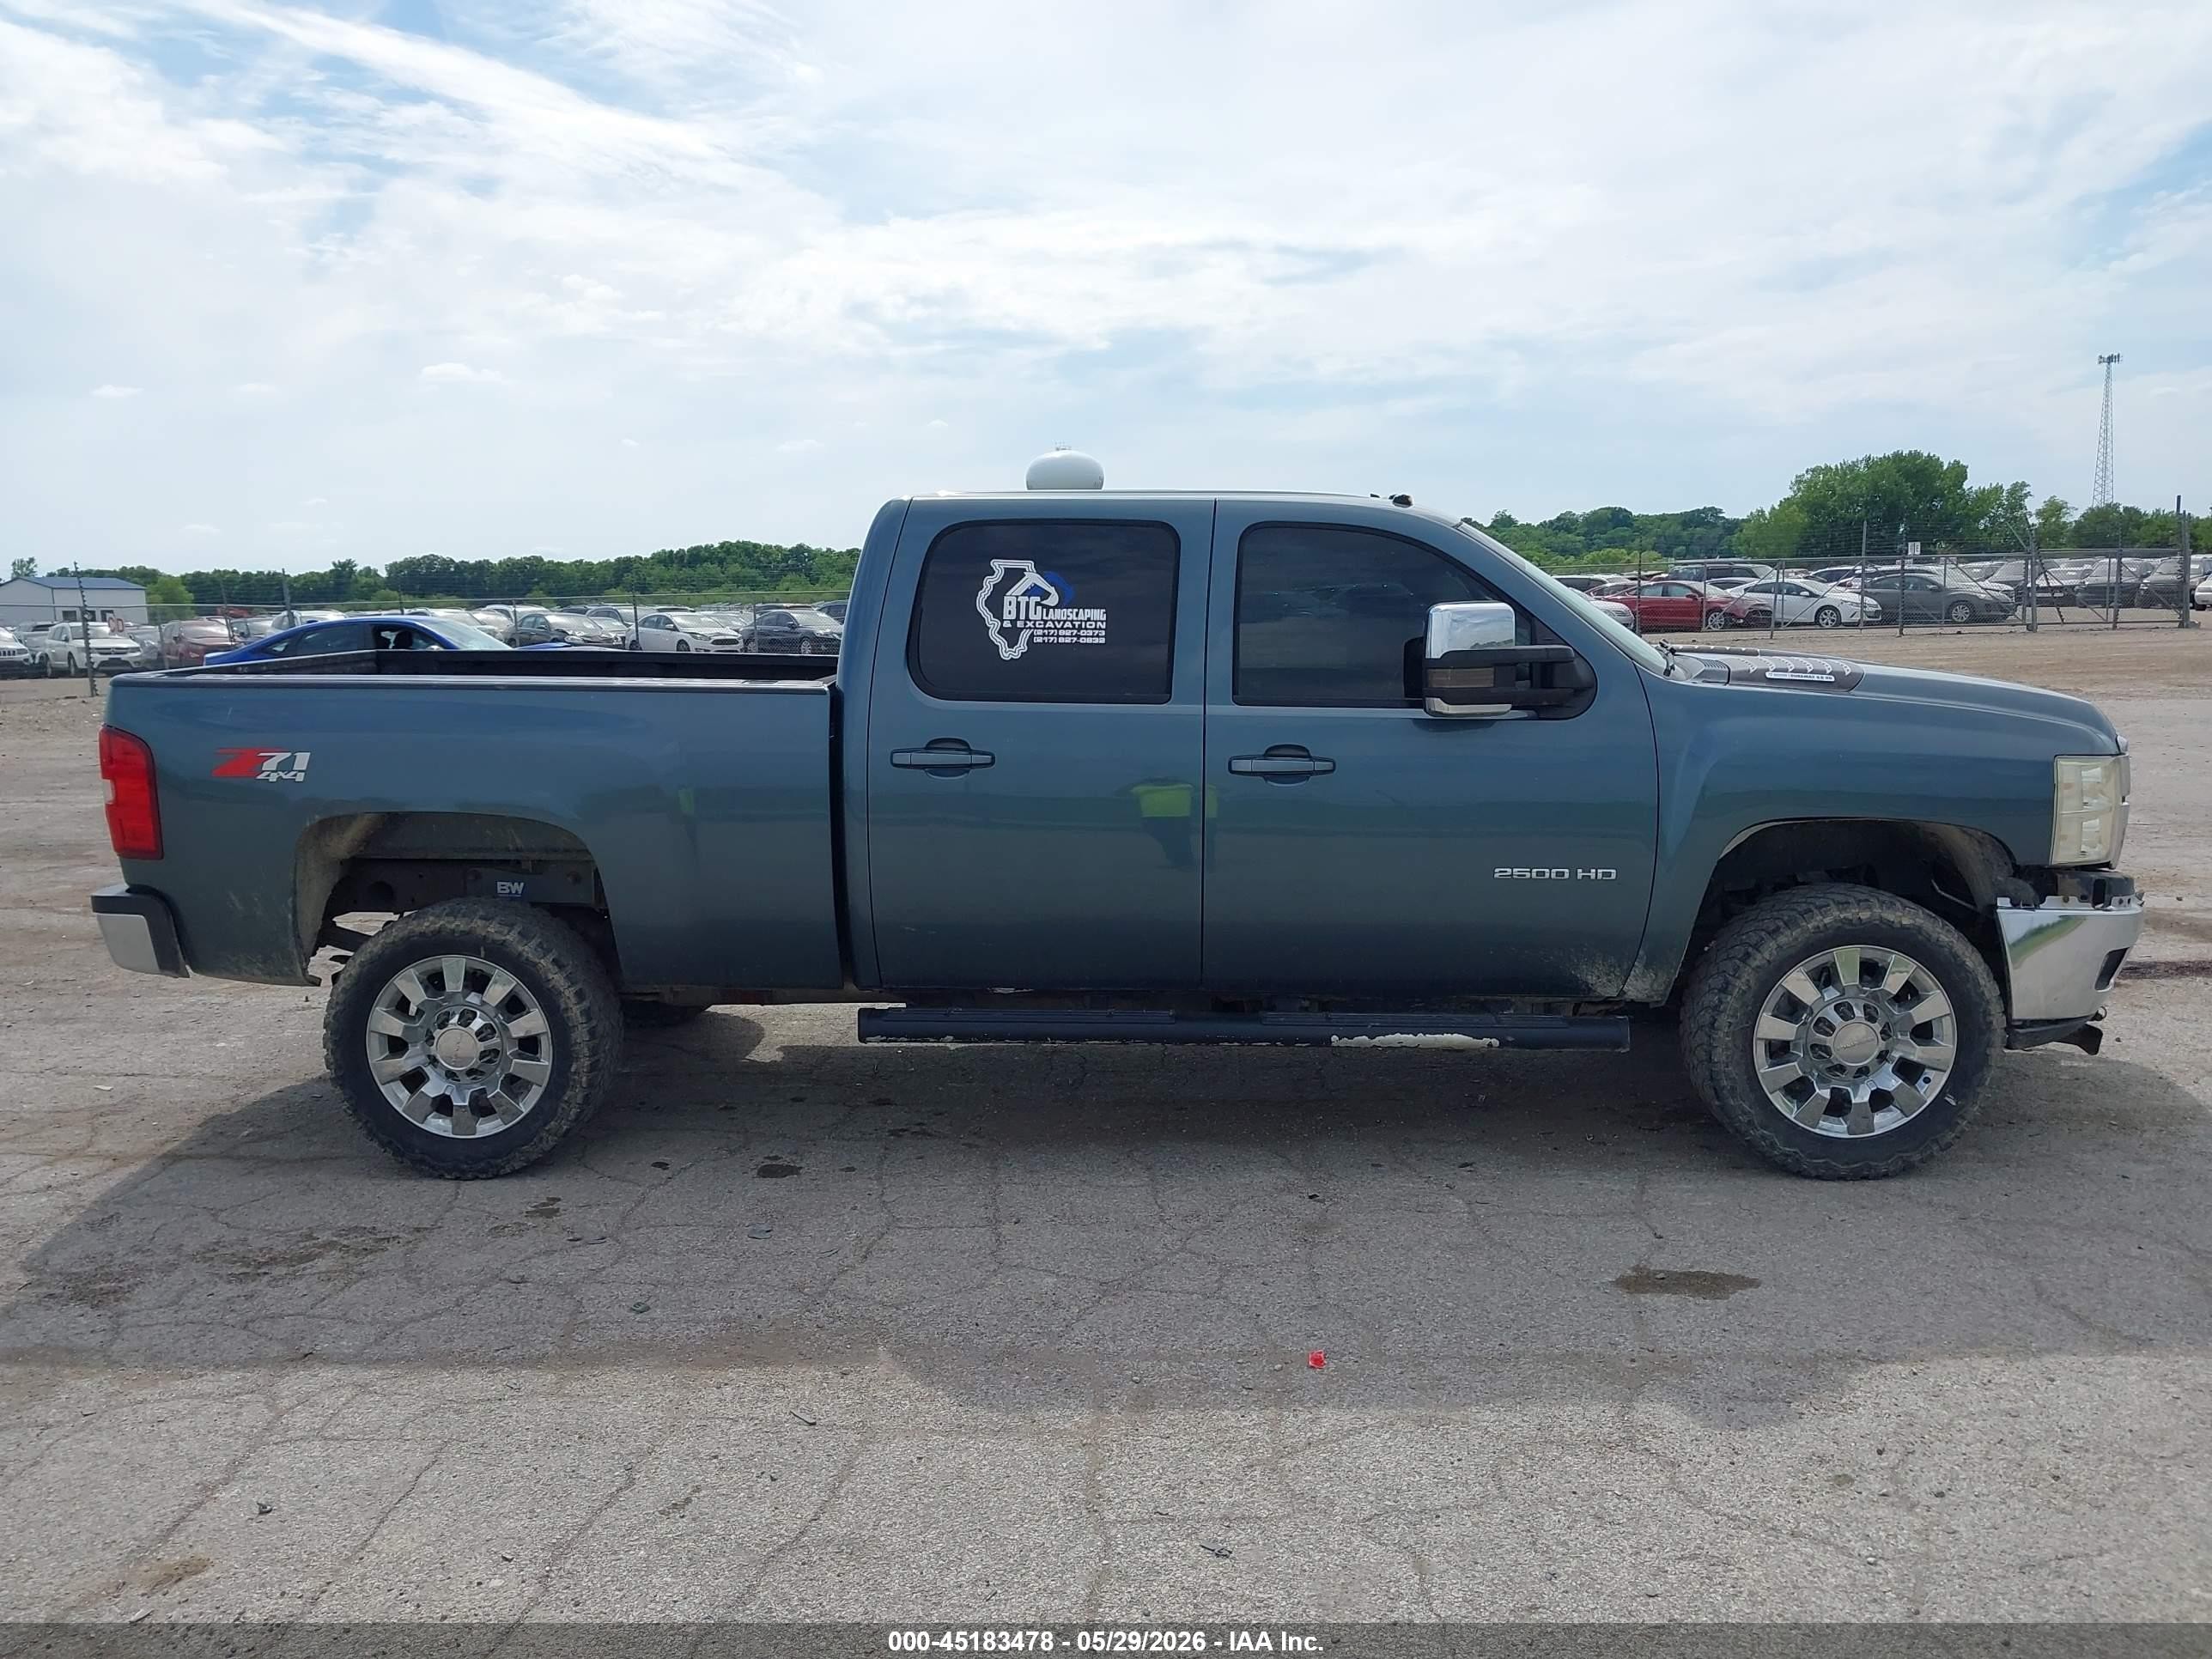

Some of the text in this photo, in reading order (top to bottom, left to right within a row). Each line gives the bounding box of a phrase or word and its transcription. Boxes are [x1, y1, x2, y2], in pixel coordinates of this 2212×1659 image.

[1003, 596, 1107, 621] BTG LANDSCAPING
[211, 747, 311, 777] Z71
[1493, 868, 1617, 879] 2500 HD
[496, 881, 525, 895] BW
